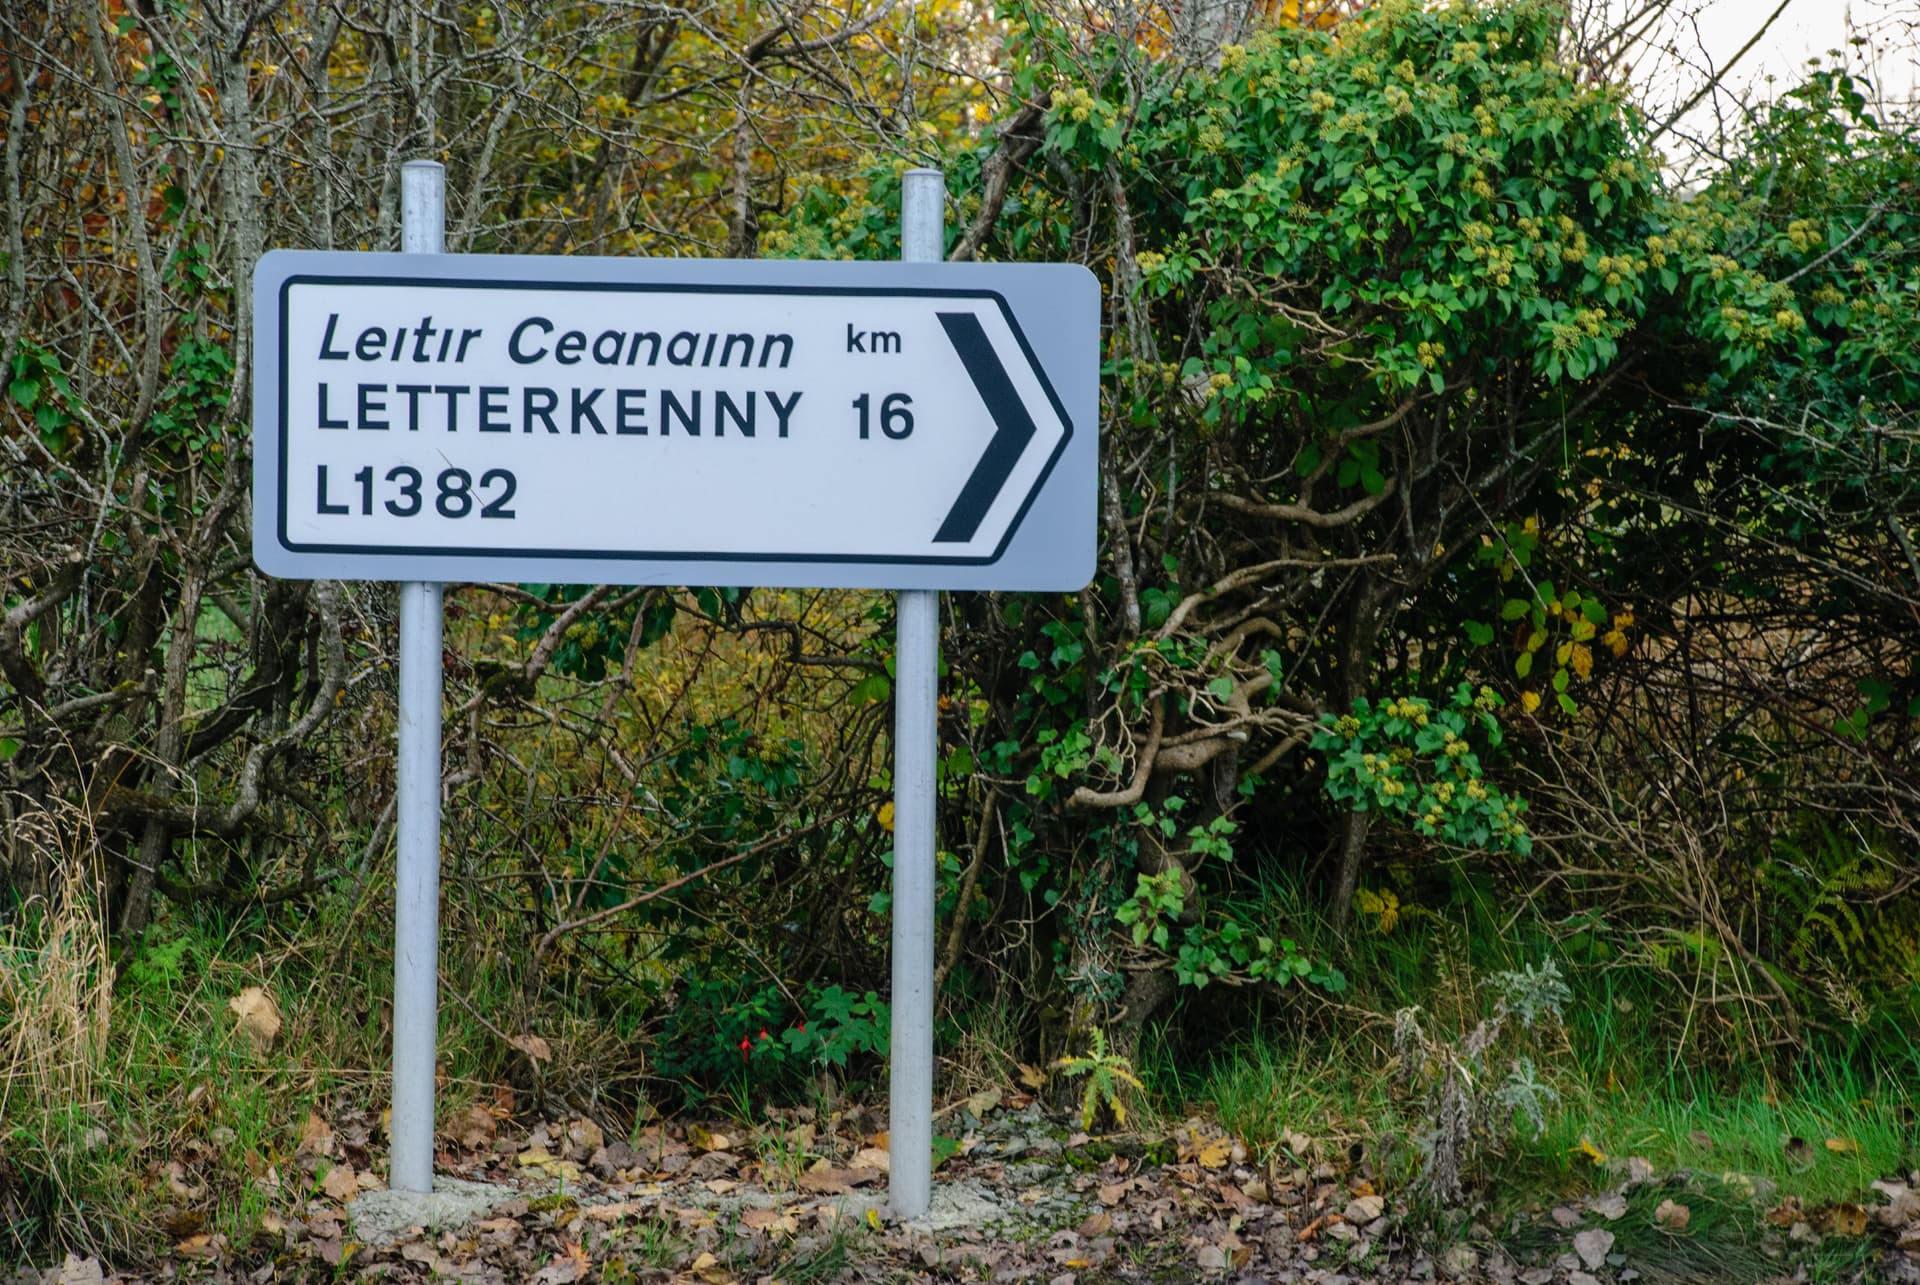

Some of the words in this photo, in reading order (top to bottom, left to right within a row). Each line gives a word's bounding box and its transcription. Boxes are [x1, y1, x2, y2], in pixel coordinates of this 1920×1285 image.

[847, 323, 902, 354] km
[318, 382, 803, 438] LETTERKENNY
[852, 392, 915, 440] 16
[316, 464, 518, 519] L1382
